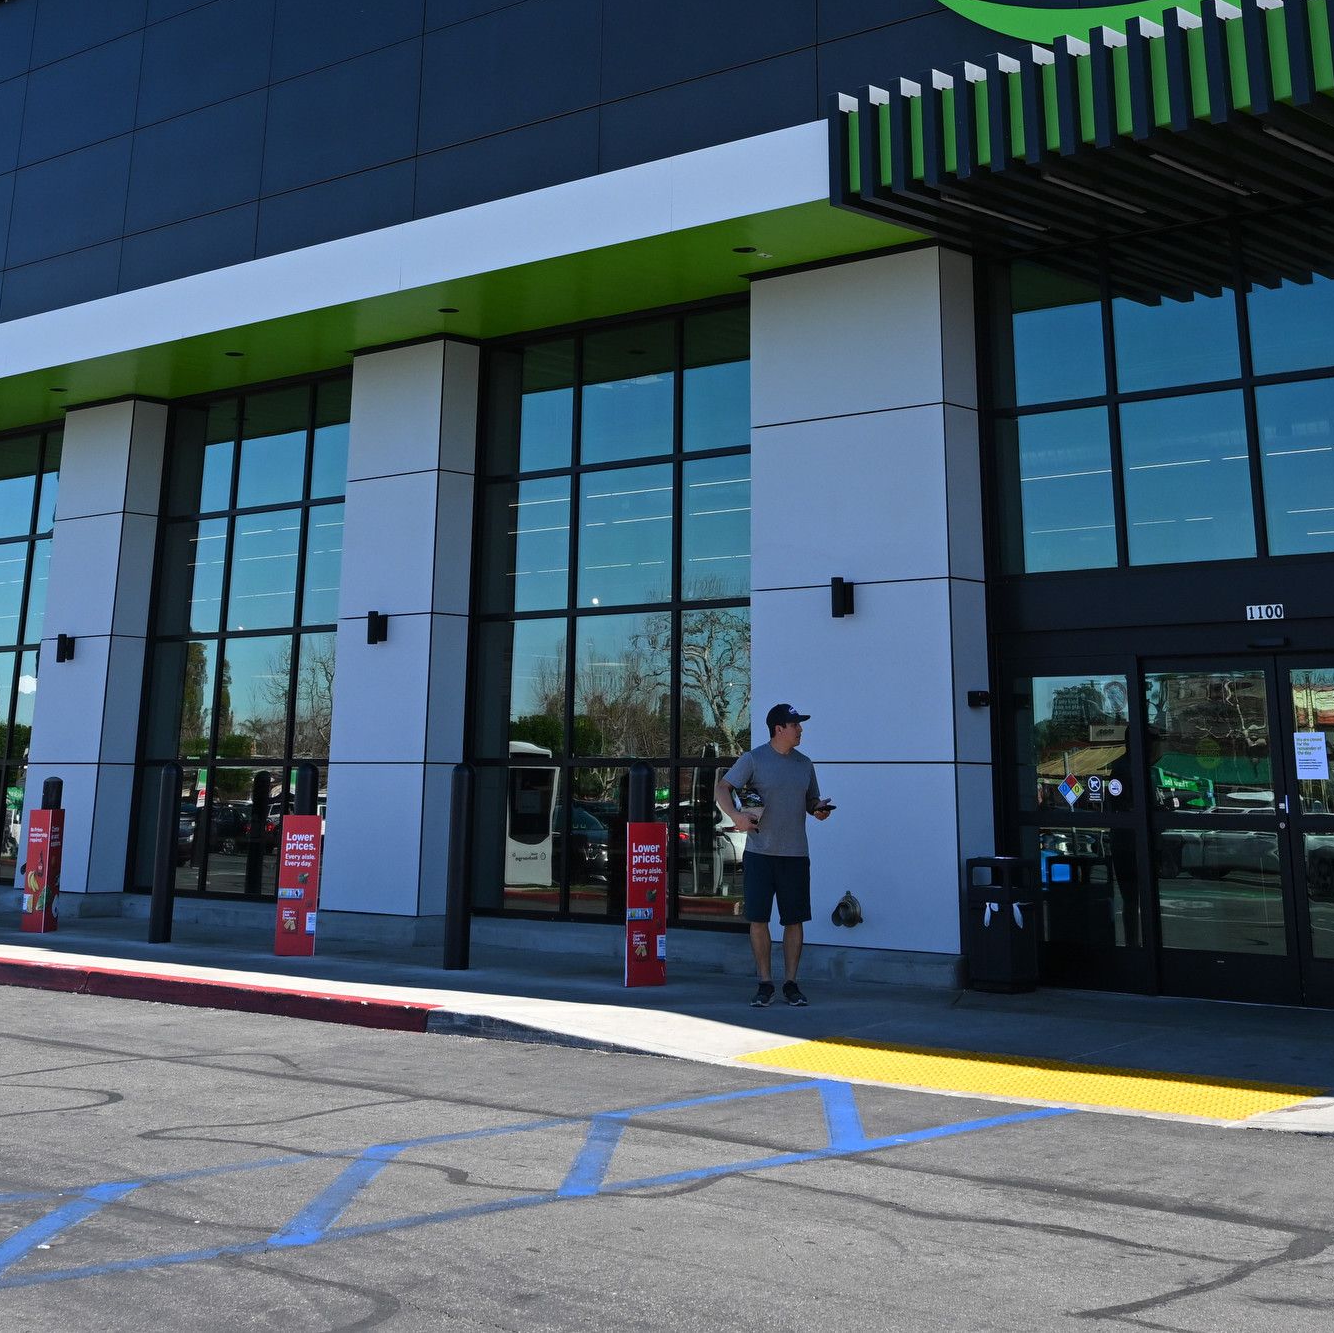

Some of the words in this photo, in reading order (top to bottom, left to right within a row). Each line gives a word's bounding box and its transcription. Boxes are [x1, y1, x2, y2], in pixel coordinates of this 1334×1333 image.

[1249, 605, 1283, 620] 1100
[286, 831, 315, 842] Lower
[285, 841, 316, 852] prices.
[632, 842, 660, 853] Lower
[285, 853, 301, 861] Every
[632, 852, 663, 866] prices.
[284, 860, 301, 868] Every
[300, 860, 312, 868] day.
[632, 867, 648, 875] Every
[632, 875, 648, 883] Every
[648, 875, 660, 883] day.
